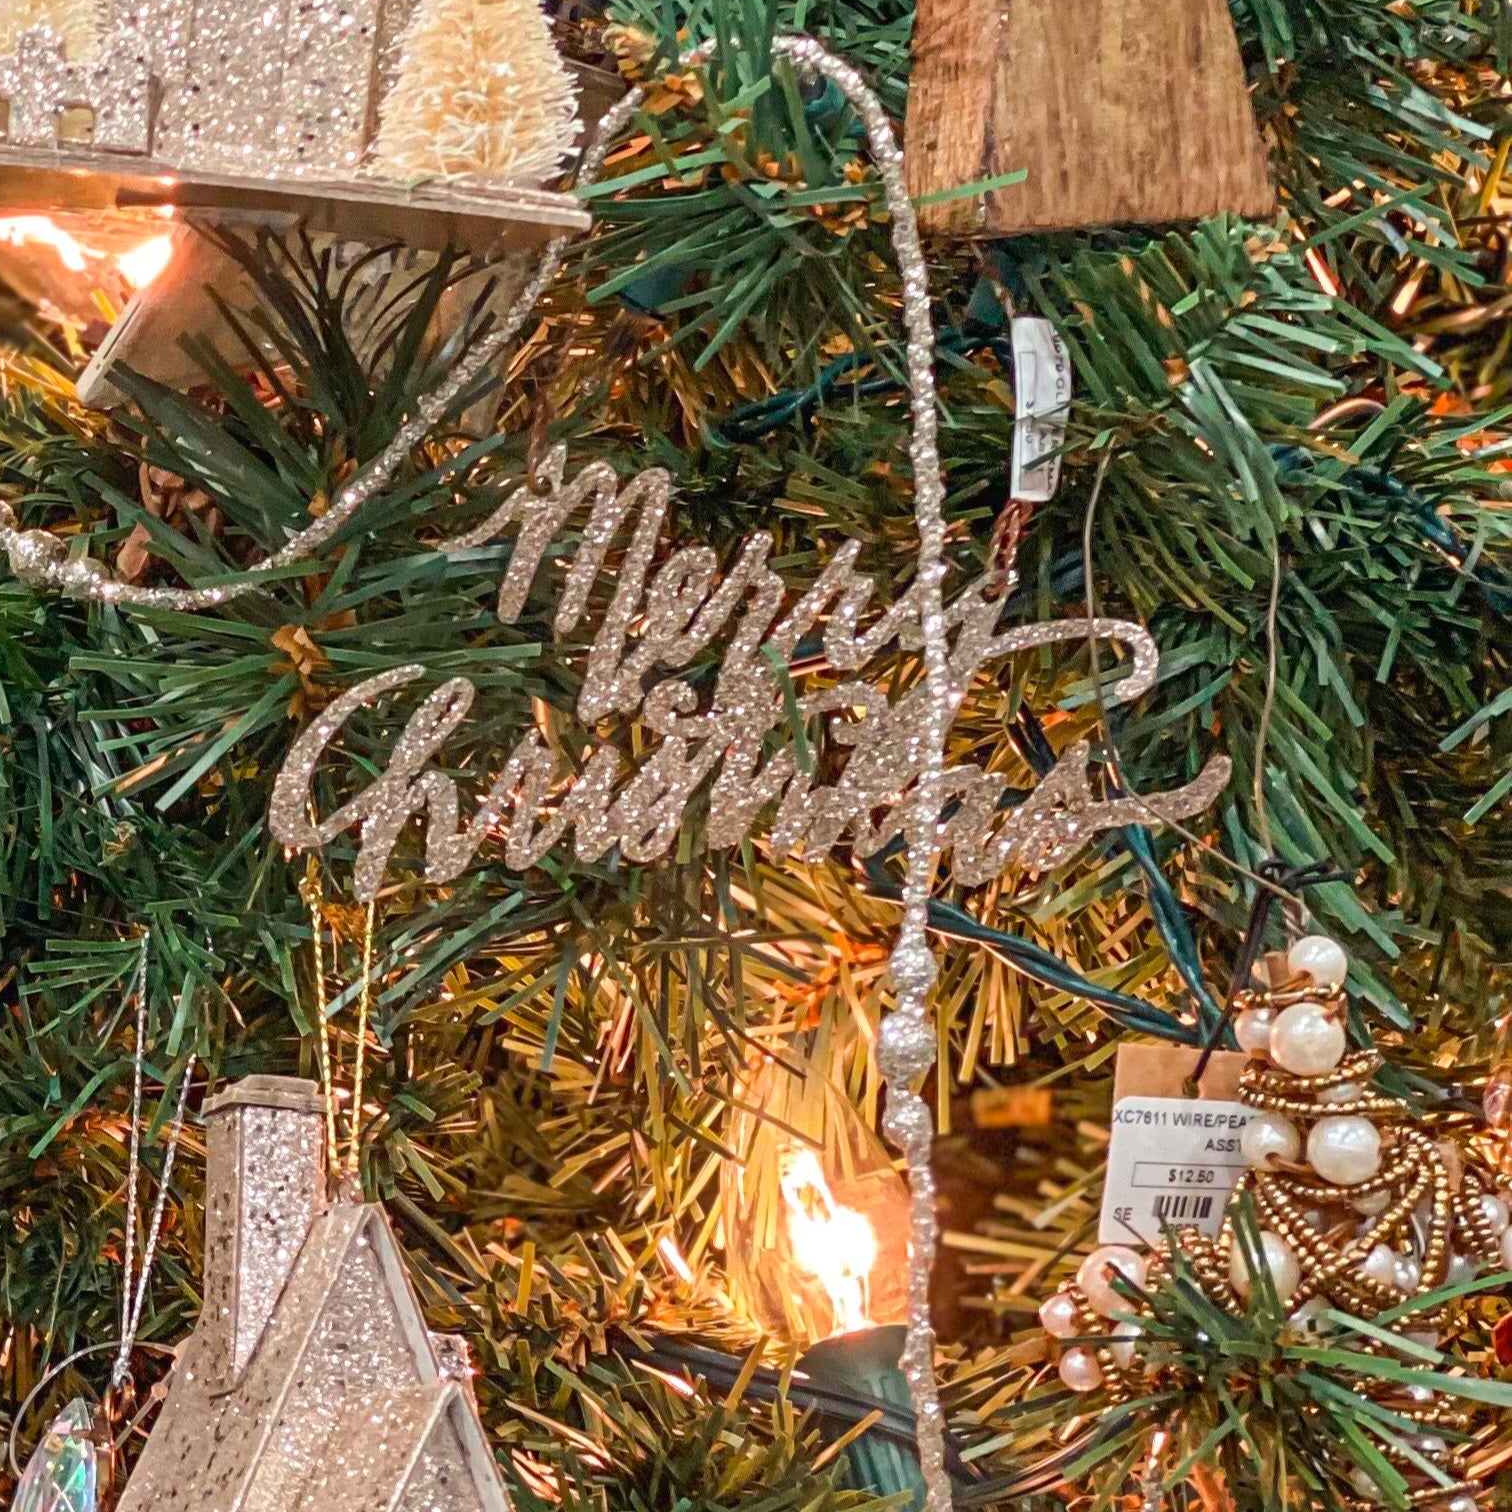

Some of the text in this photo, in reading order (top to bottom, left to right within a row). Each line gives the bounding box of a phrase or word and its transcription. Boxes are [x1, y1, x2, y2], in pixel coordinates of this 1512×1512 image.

[1173, 1112, 1254, 1129] WIRE/PEA
[1168, 1168, 1215, 1184] $12.50
[1113, 1206, 1133, 1222] SE
